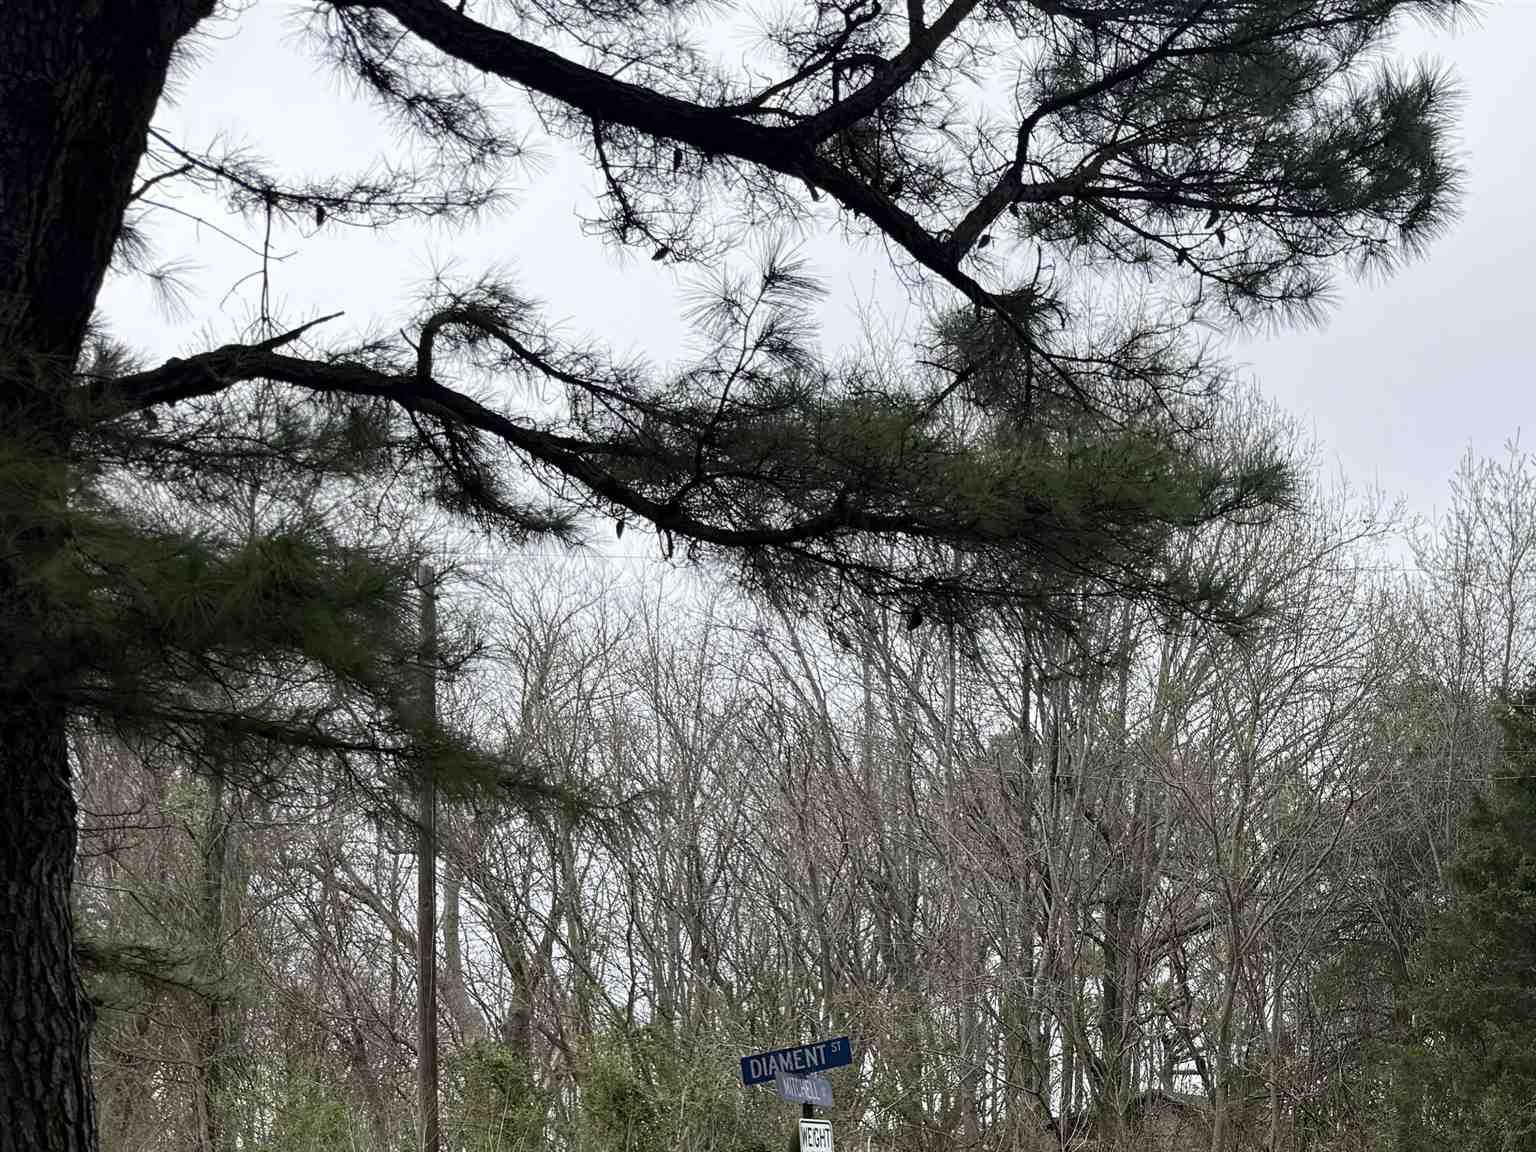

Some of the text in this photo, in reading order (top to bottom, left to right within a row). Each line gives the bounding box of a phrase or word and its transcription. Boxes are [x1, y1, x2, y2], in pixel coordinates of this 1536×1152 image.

[751, 1041, 841, 1078] DIAMENT ST
[784, 1078, 820, 1100] MITCHELL
[800, 1128, 830, 1147] WEIGHT
